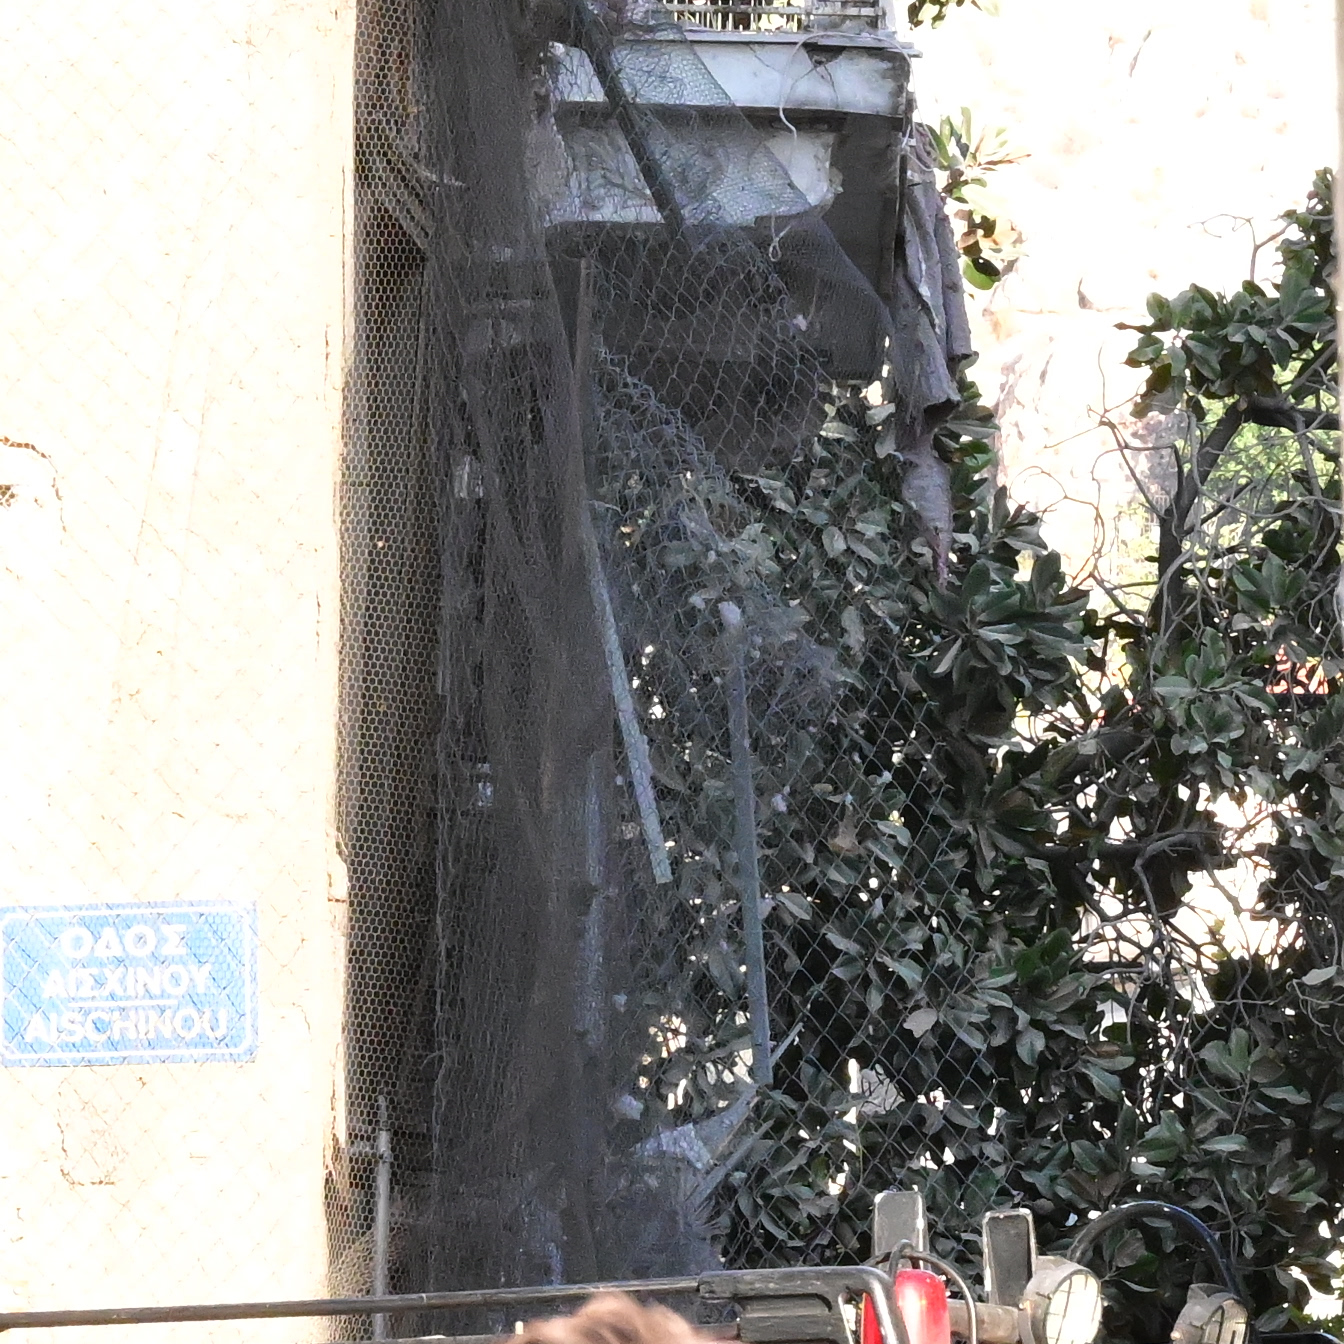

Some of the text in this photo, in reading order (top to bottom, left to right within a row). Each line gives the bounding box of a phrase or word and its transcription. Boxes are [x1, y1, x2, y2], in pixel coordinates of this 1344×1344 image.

[59, 924, 187, 959] ΟΔΟΣ
[41, 963, 212, 999] ΑΙΣΧΙΝΟΥ
[25, 1008, 229, 1043] AISCHINOU
